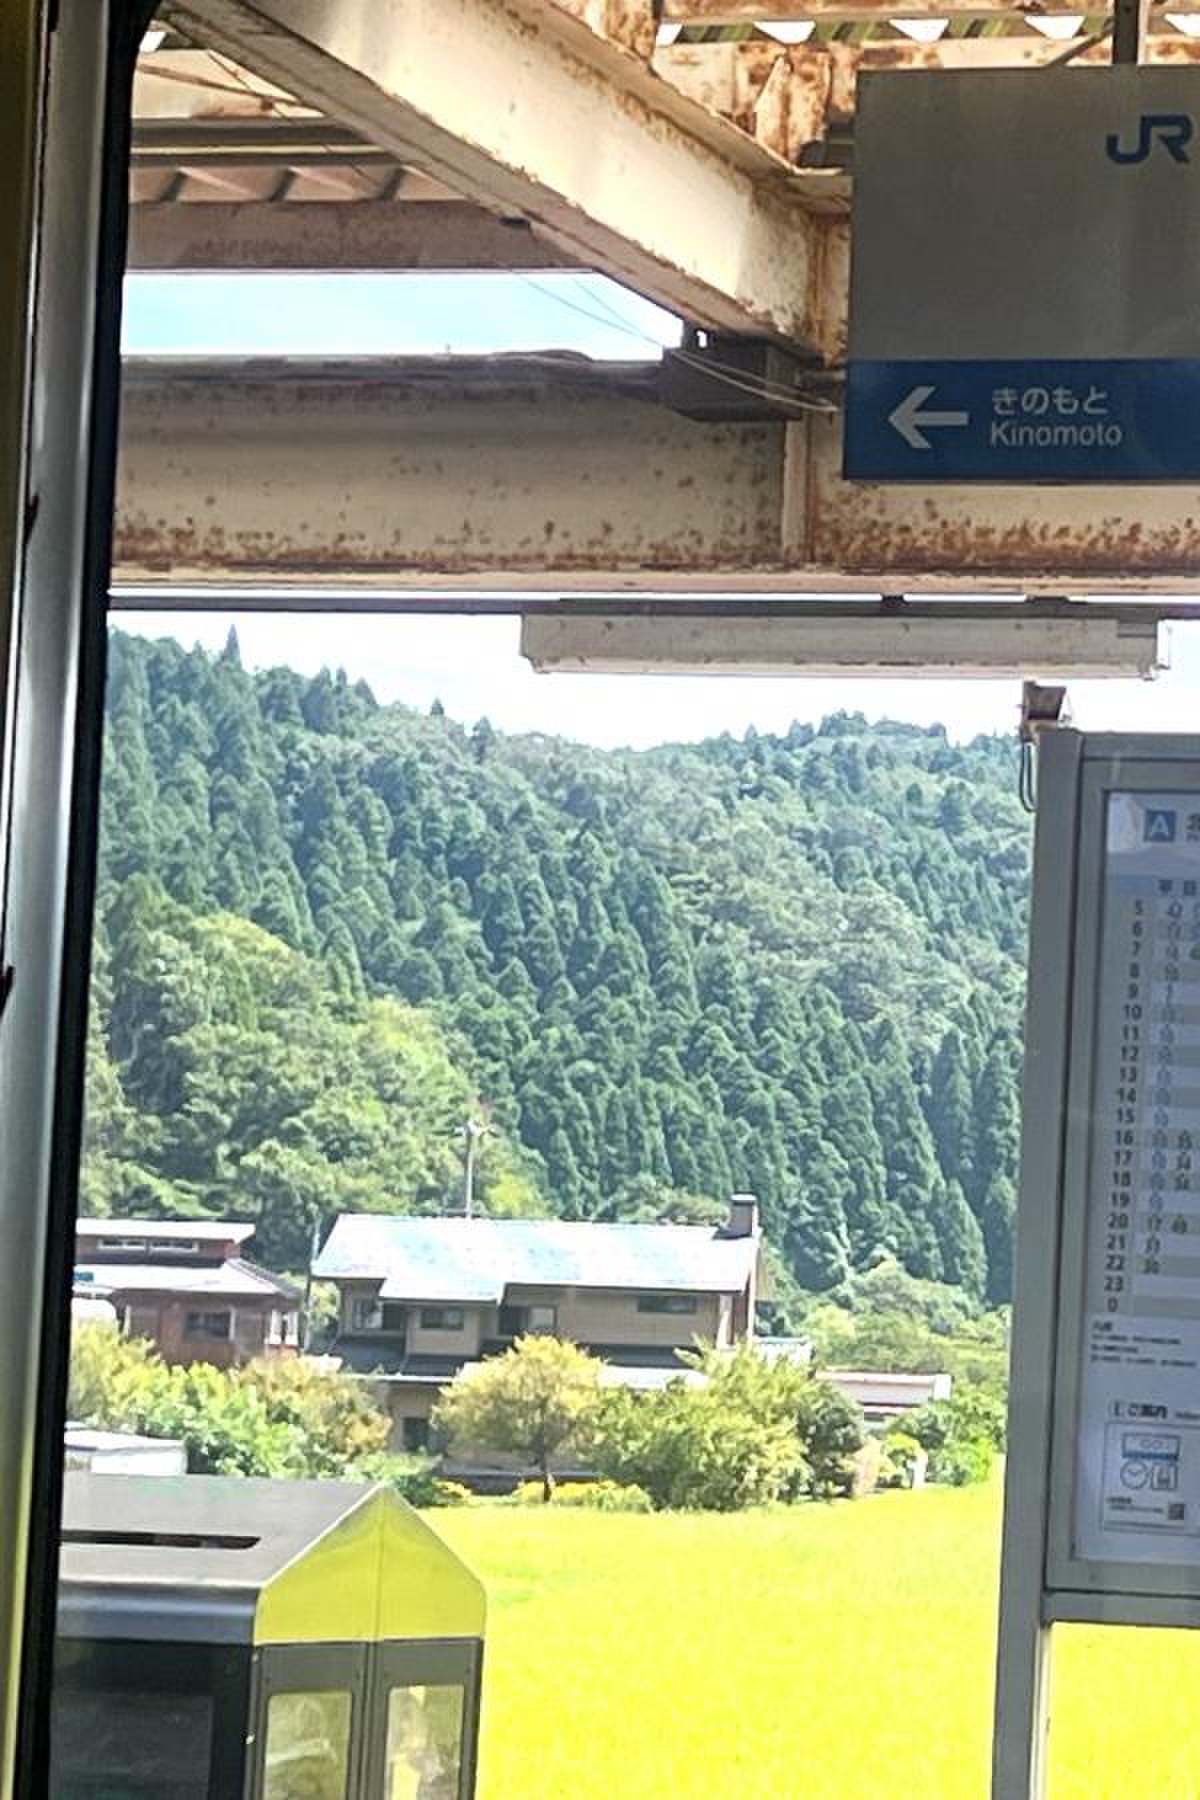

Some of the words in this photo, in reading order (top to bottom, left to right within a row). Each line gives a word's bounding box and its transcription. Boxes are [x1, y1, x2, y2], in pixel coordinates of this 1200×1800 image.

[1106, 113, 1195, 165] JR
[992, 385, 1109, 415] きのもと
[991, 420, 1123, 447] Kinomoto
